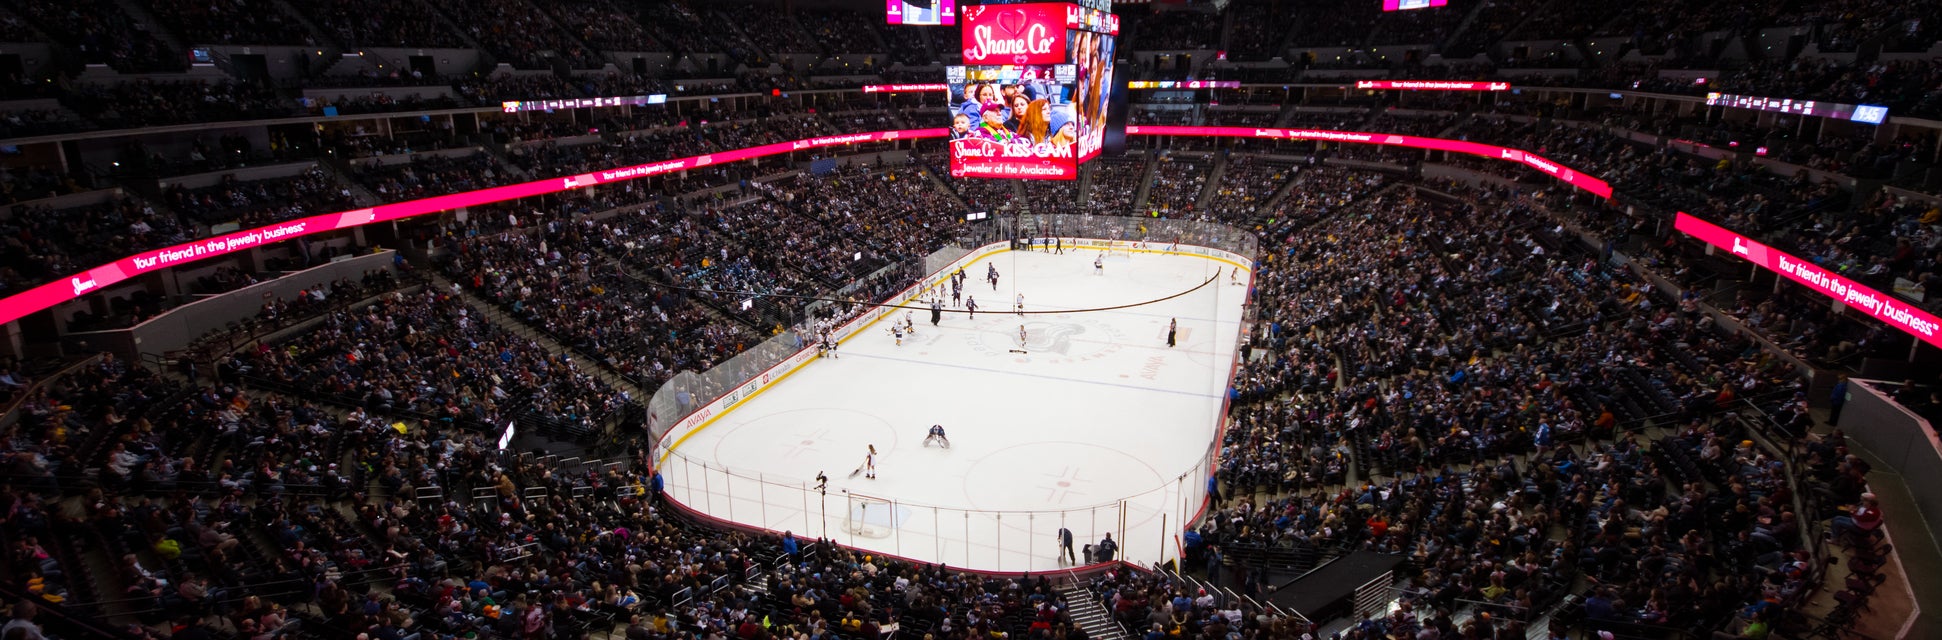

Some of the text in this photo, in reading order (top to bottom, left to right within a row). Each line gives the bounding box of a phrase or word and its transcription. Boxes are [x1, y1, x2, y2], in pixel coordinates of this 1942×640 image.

[974, 25, 1027, 60] Shane
[955, 141, 982, 158] Shane
[963, 163, 1064, 175] Jeweler of the Avalanche
[133, 256, 157, 270] Your
[159, 245, 194, 264] friend
[195, 244, 206, 256] in
[207, 240, 225, 253] the
[226, 231, 262, 251] jewelry
[1778, 255, 1796, 273] Your
[1796, 263, 1821, 285] friend
[1820, 273, 1829, 289] in
[1830, 277, 1846, 296] the
[1845, 284, 1883, 315] jewelry
[686, 409, 711, 430] AVAYA
